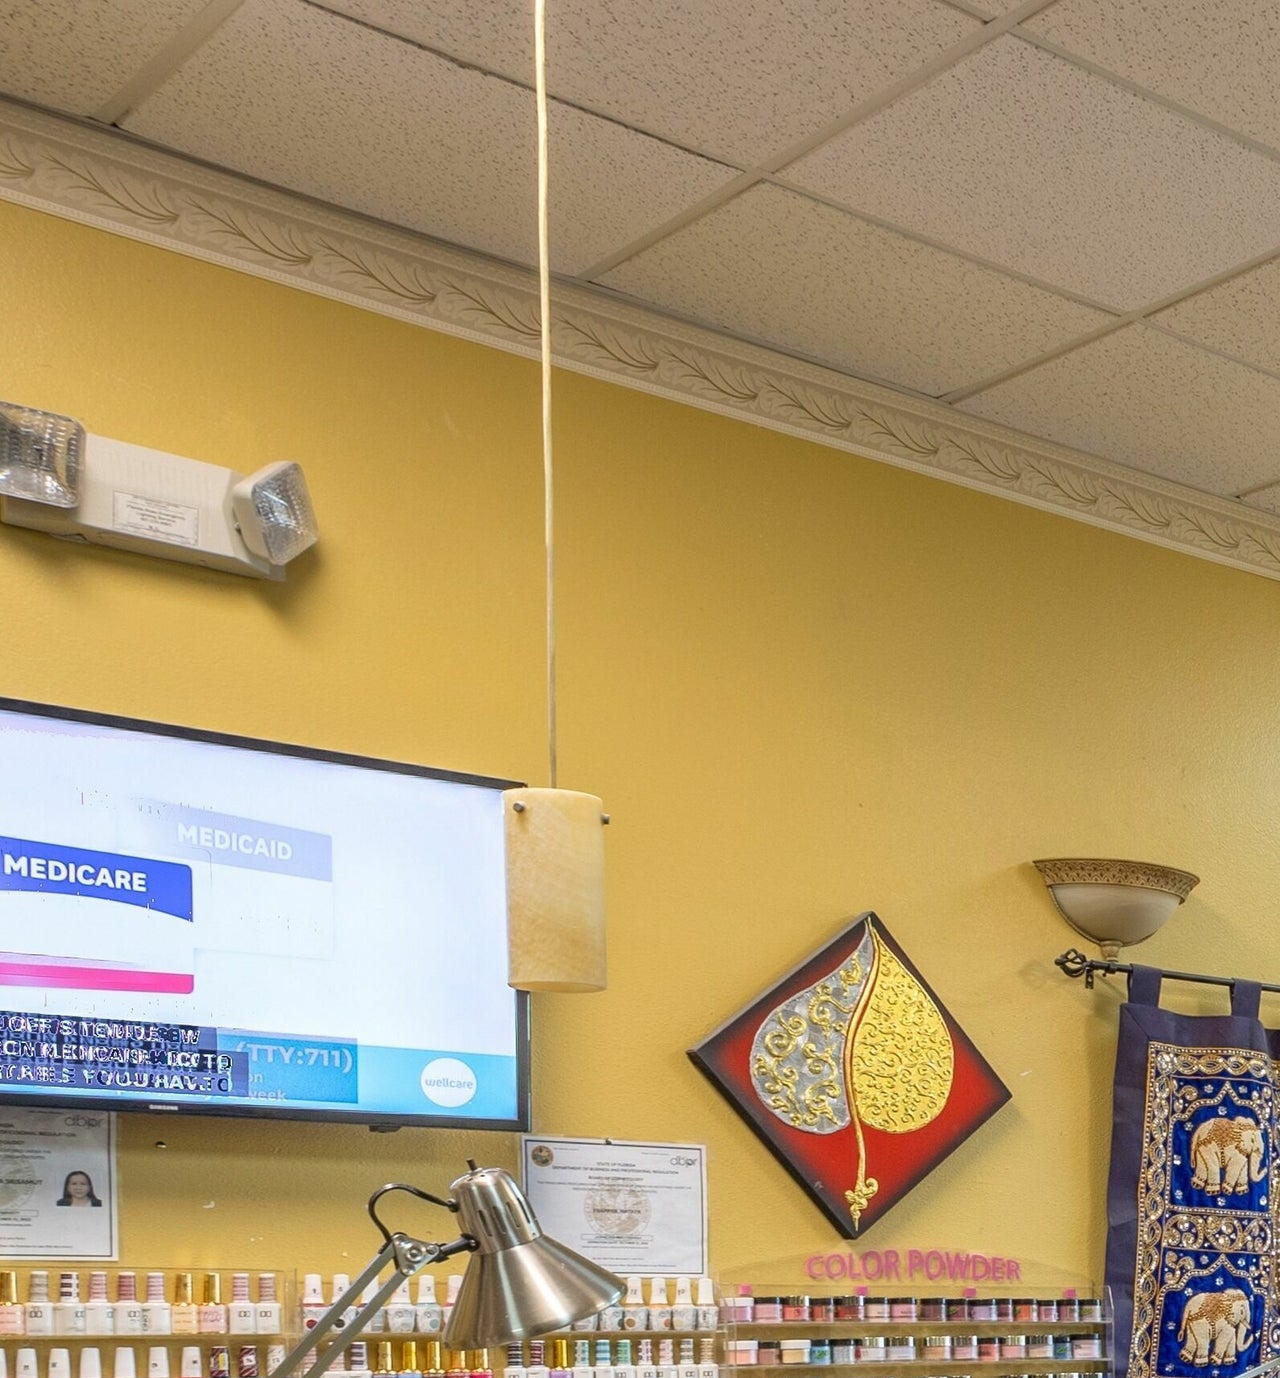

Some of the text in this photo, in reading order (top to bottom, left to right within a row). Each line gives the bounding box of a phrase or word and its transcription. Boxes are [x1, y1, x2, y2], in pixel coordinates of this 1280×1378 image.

[177, 822, 293, 862] MEDICAID
[3, 853, 147, 893] MEDICARE
[236, 1042, 353, 1074] (TTY:711)
[424, 1076, 474, 1091] wellcare
[806, 1249, 1021, 1281] COLOR POWDER
